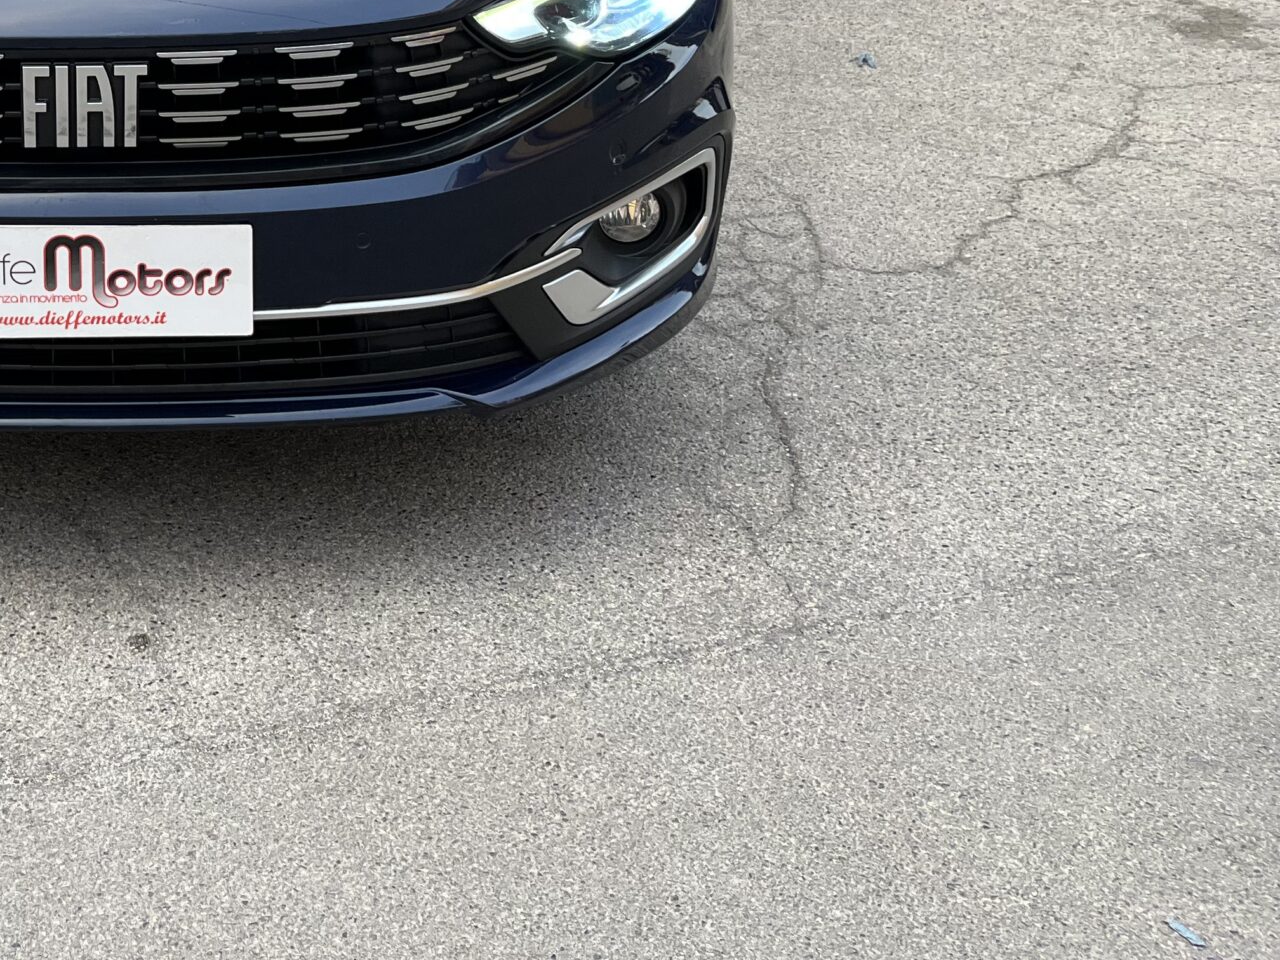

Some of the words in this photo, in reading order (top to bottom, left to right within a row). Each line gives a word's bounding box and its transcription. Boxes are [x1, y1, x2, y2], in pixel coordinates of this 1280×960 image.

[22, 64, 148, 148] FIAT
[20, 293, 28, 303] in
[30, 293, 88, 304] movimento
